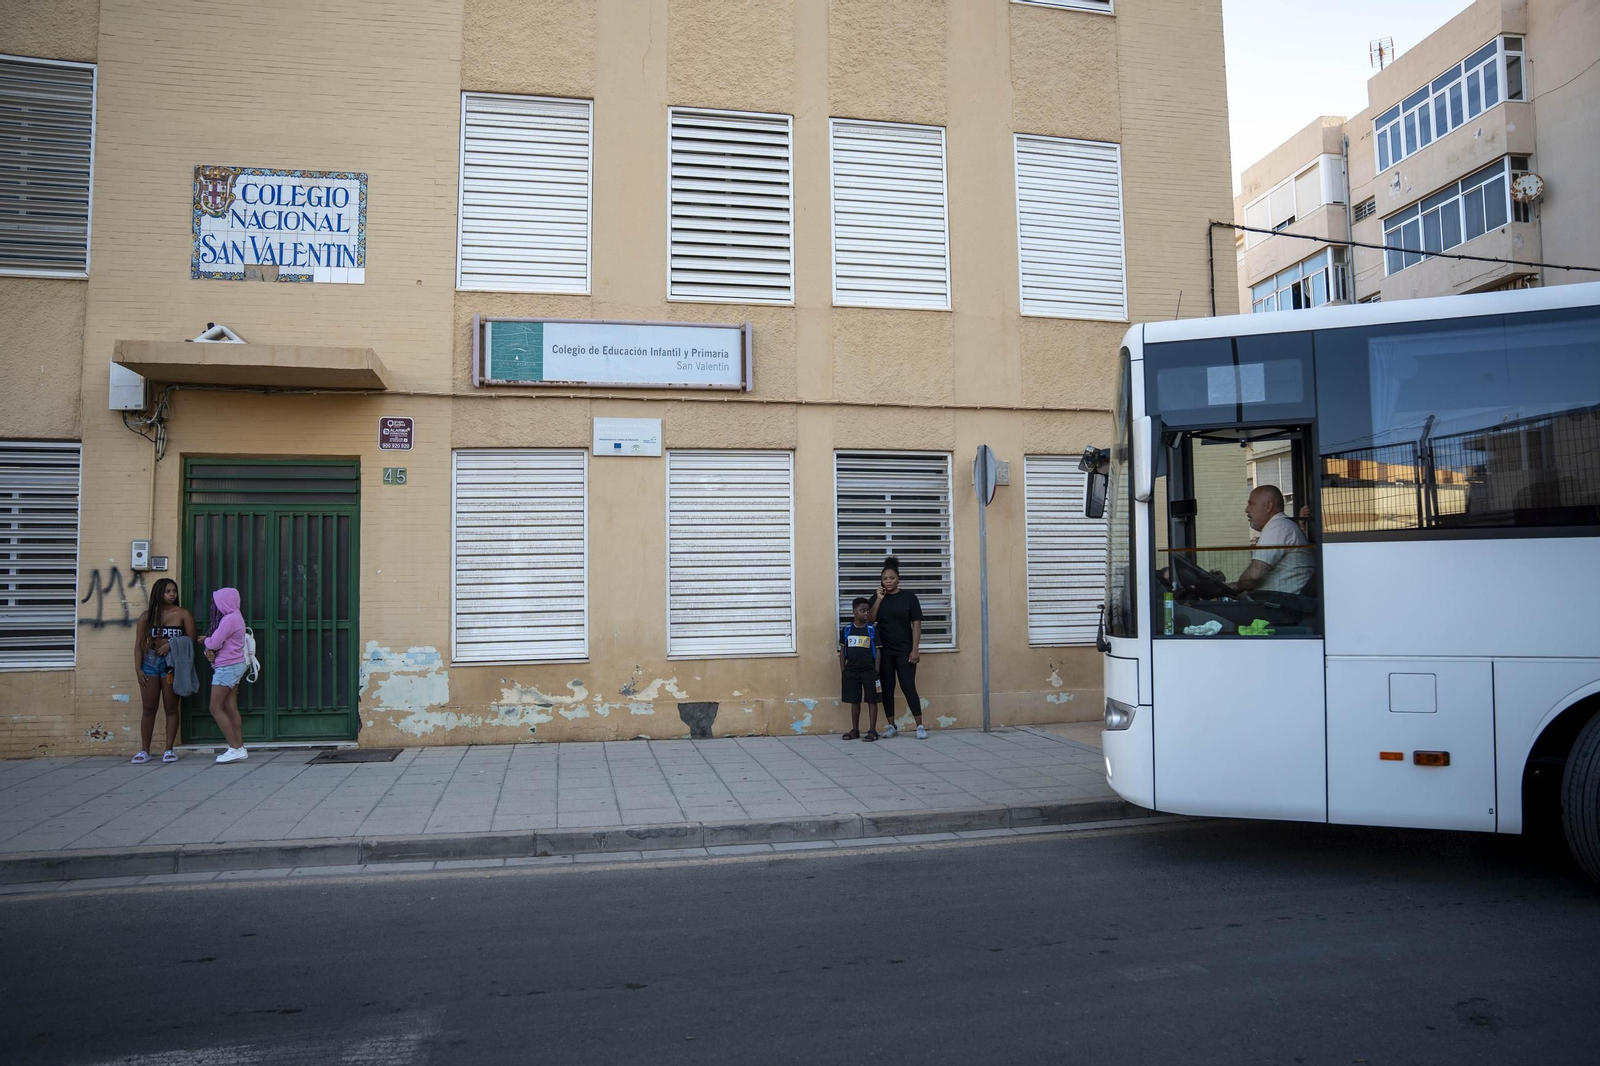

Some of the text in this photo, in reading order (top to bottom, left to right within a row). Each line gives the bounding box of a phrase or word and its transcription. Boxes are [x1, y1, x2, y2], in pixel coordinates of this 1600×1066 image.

[242, 183, 350, 208] COLEGIO
[230, 208, 351, 233] NACIONAL
[201, 233, 356, 268] SAN VALENTIN
[552, 344, 729, 359] Colegio de Educación Infantil y Primaria
[676, 361, 730, 372] San Valentín
[384, 468, 406, 484] 45
